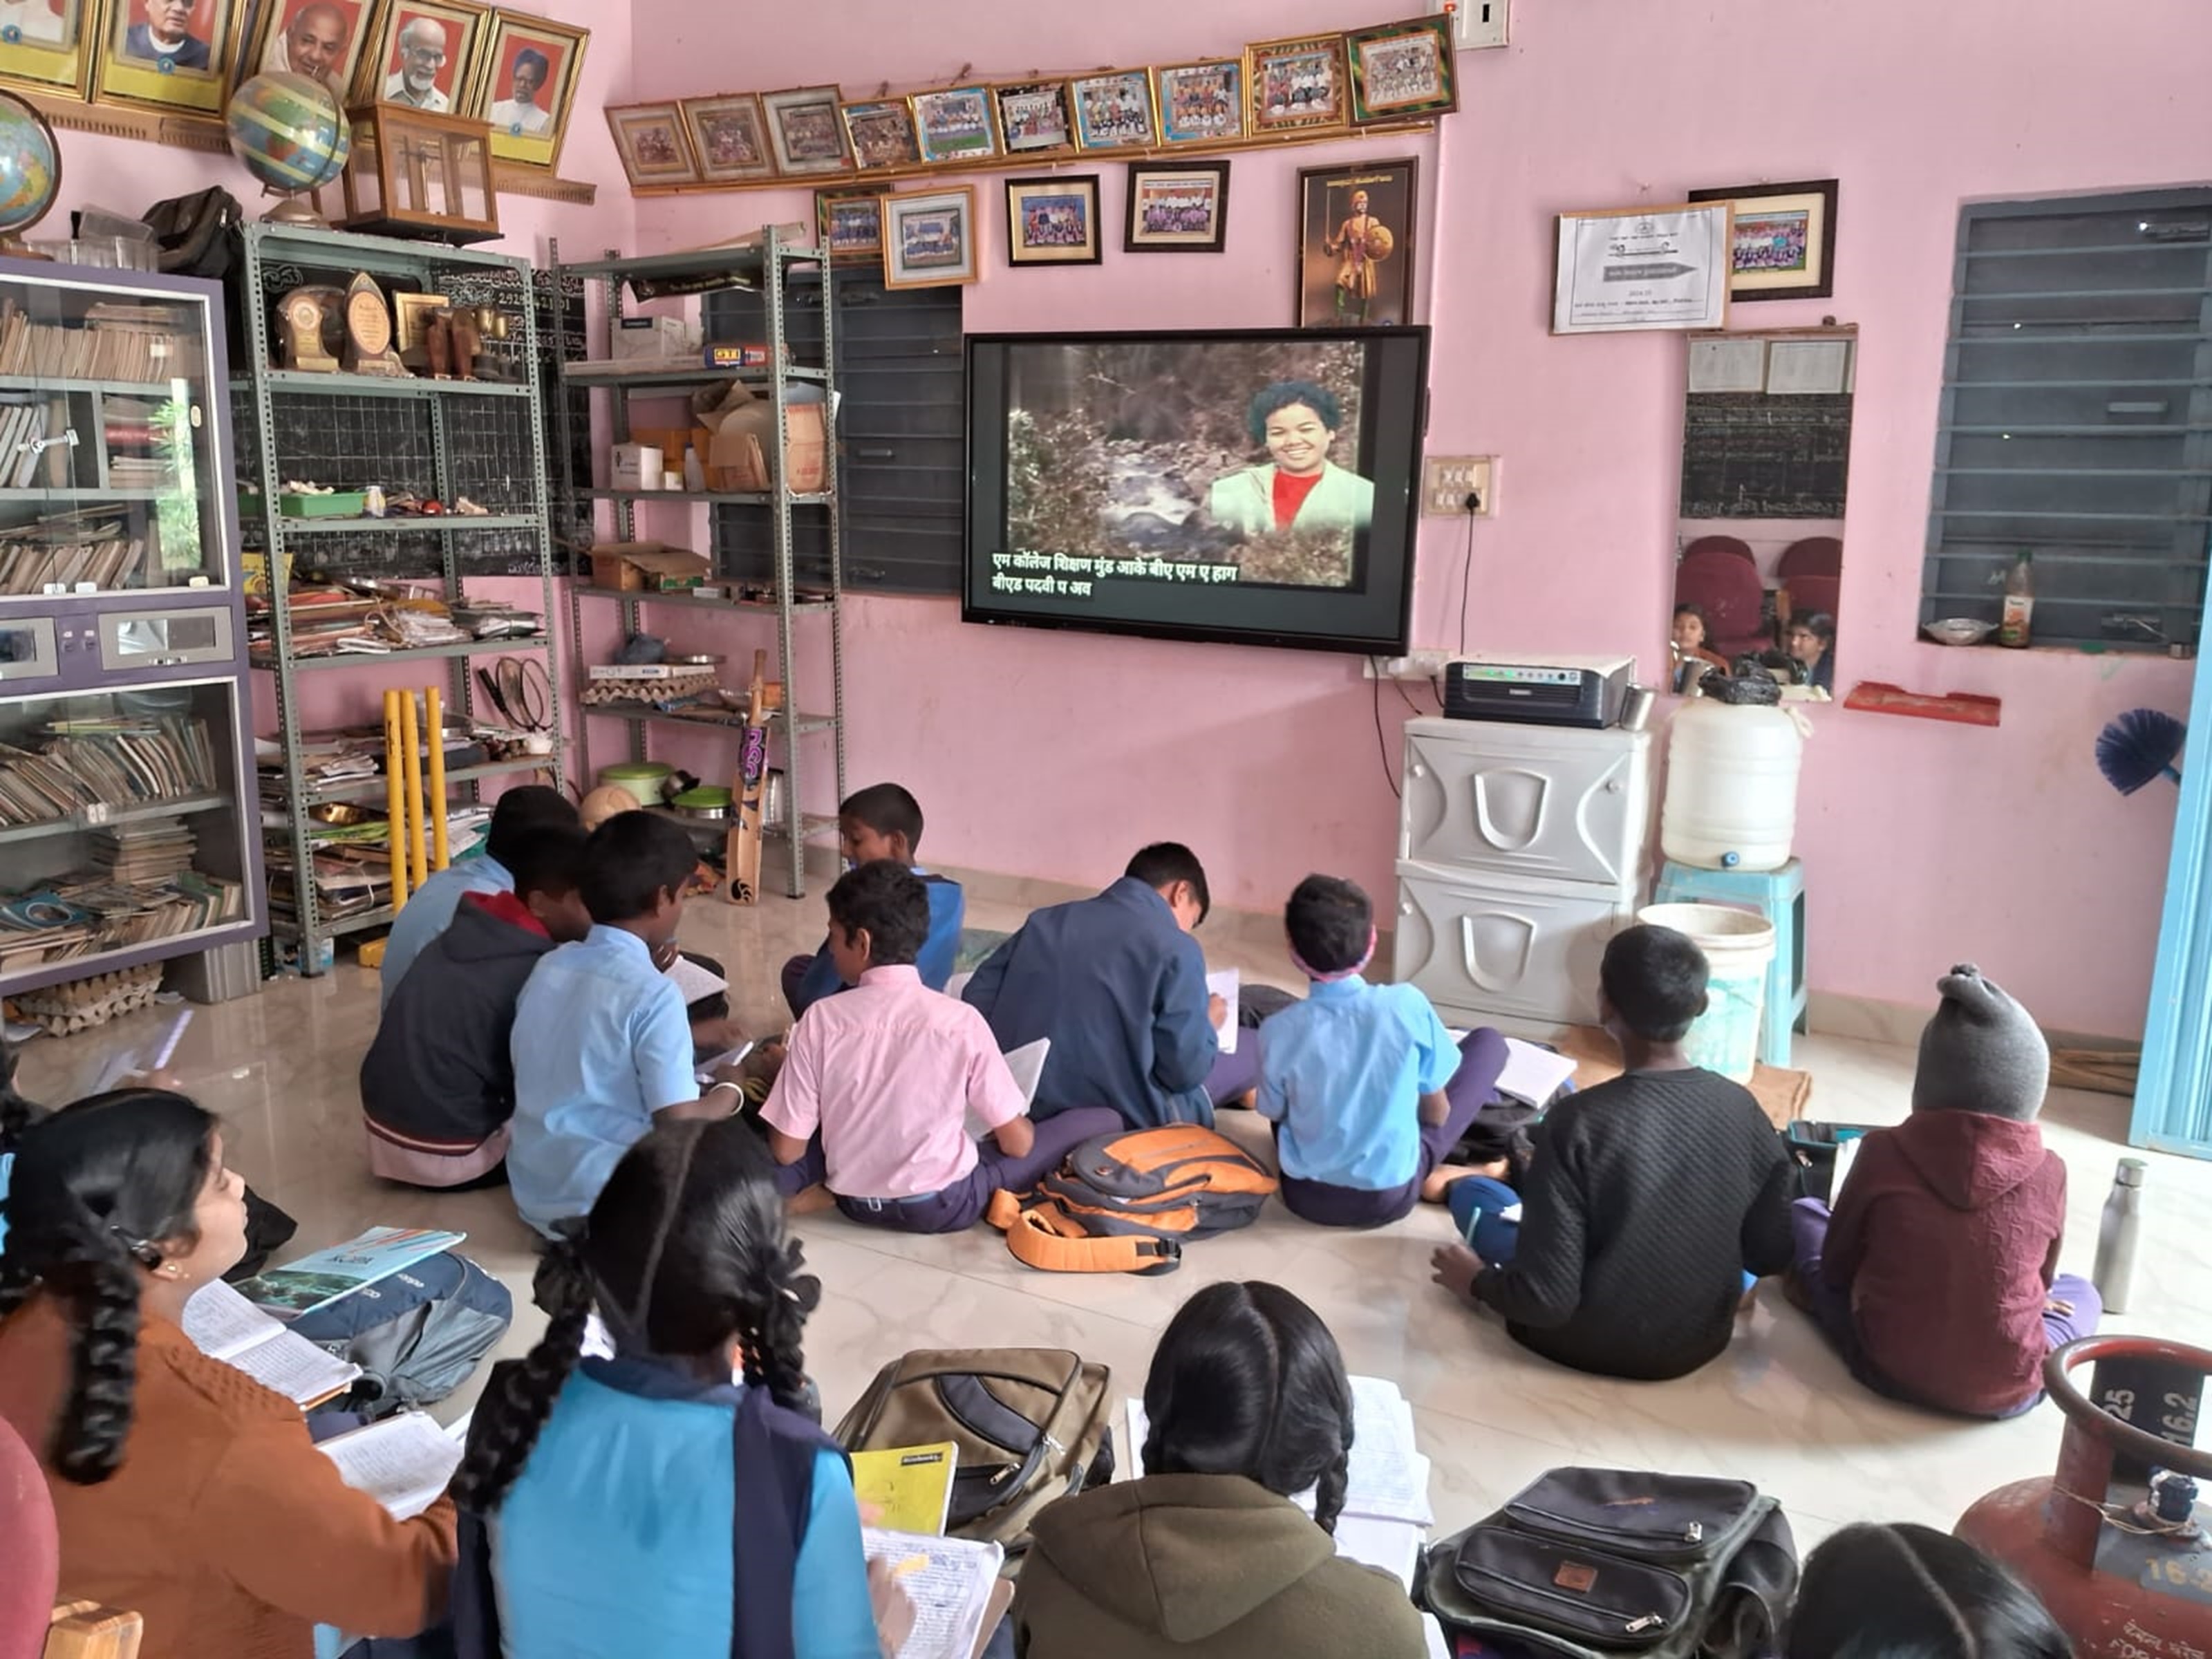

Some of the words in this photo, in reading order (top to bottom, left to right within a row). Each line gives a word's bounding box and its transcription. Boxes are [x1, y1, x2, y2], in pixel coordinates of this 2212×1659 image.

[992, 552, 1011, 570] एम
[1013, 550, 1051, 570] कॉलेज
[1053, 552, 1092, 572] शिक्षण
[1117, 556, 1147, 576] आके
[1176, 563, 1197, 582] एम
[1199, 565, 1211, 583] ए
[1212, 565, 1238, 583] हाग
[1024, 574, 1055, 594] पदवी
[1057, 579, 1069, 594] प
[1069, 581, 1092, 597] अव
